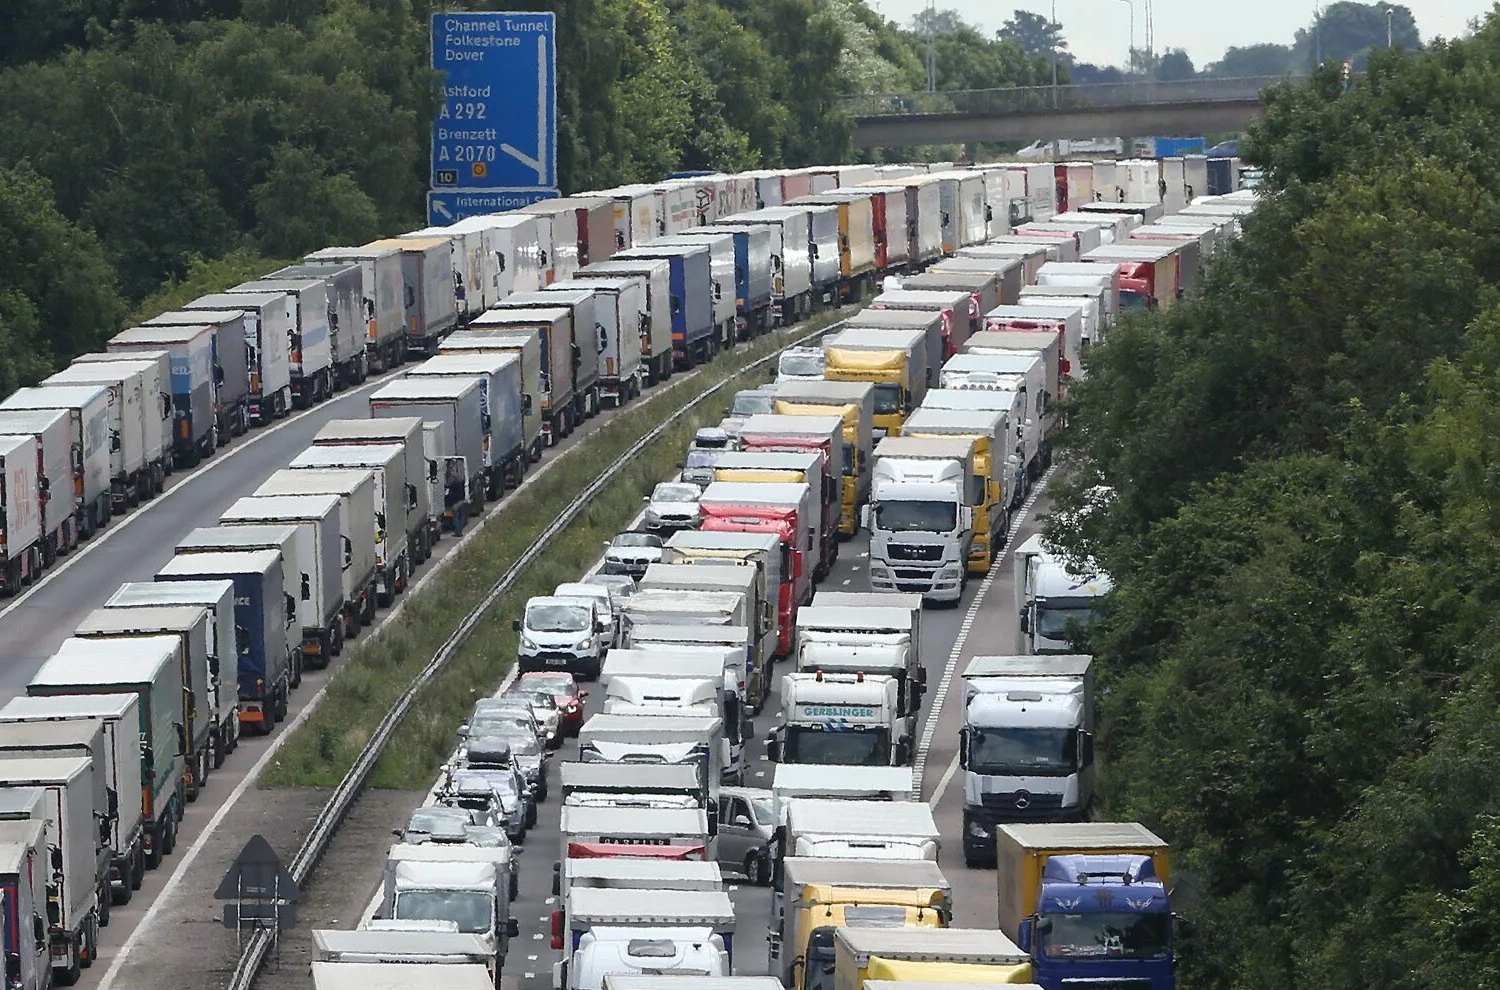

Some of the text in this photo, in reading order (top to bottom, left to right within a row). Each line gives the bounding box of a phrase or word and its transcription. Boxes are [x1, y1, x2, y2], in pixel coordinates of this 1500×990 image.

[444, 19, 548, 32] Channel Tunnel
[445, 35, 520, 47] Folkestone
[445, 49, 484, 61] Dover
[442, 85, 491, 98] Ashford
[439, 103, 487, 120] A 292
[438, 128, 498, 141] Brenzett
[439, 146, 496, 161] A 2070
[439, 173, 453, 183] 10
[456, 196, 530, 207] International
